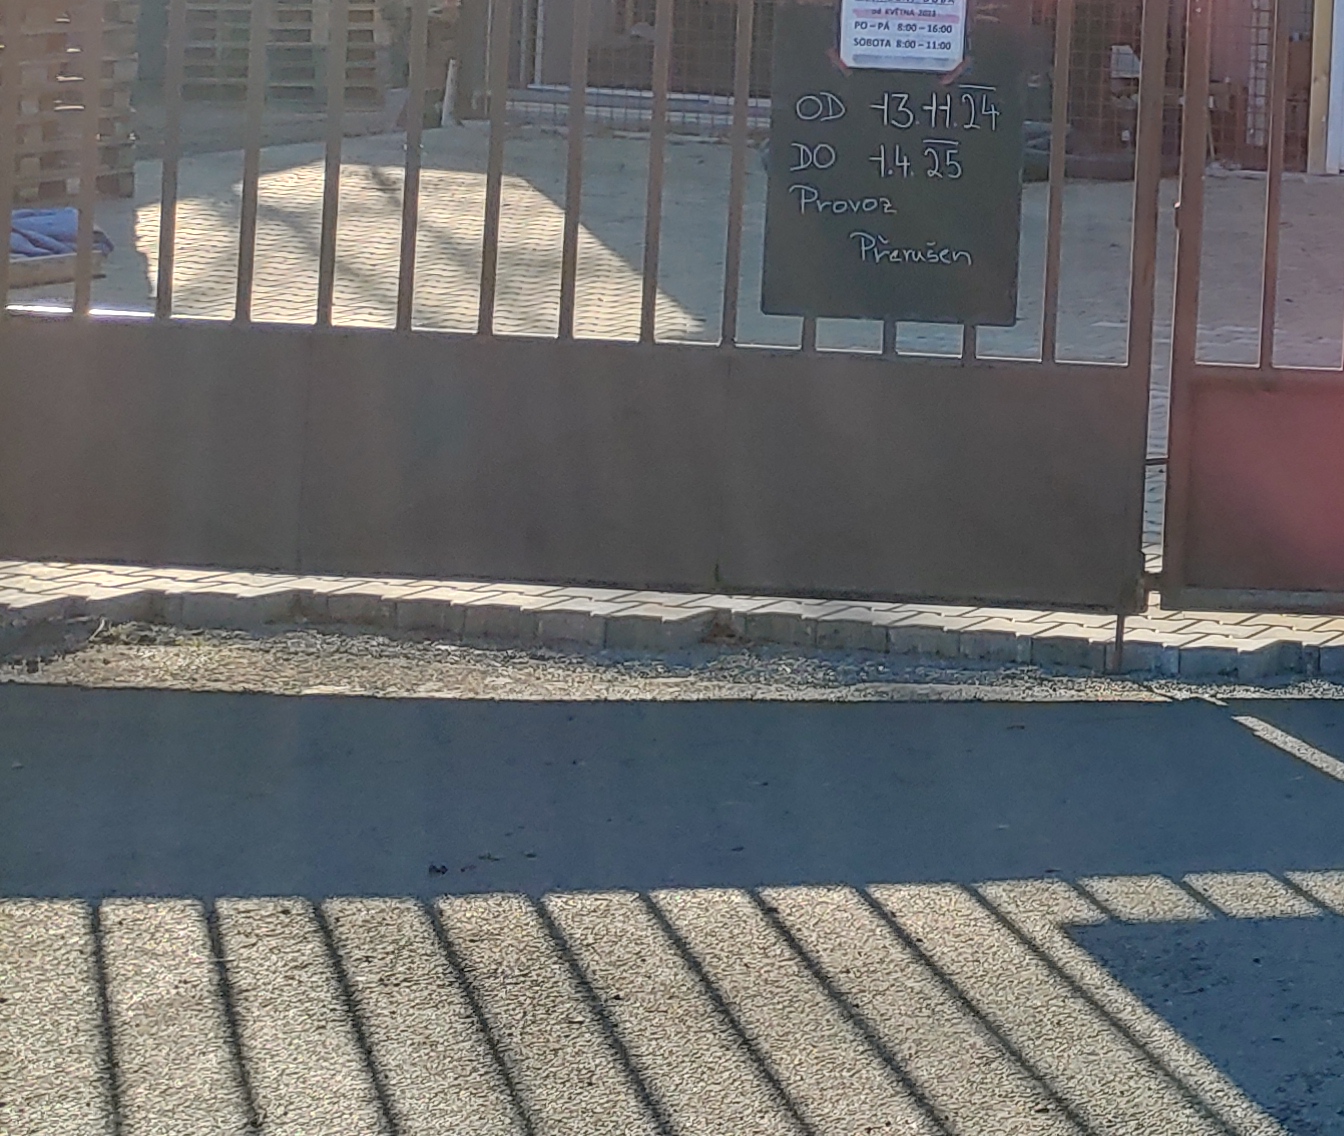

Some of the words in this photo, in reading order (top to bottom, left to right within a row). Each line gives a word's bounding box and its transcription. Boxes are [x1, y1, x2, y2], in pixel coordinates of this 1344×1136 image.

[853, 37, 891, 48] SOBOTA
[796, 92, 846, 121] OD
[789, 142, 836, 171] DO
[789, 185, 897, 214] Provoz
[850, 231, 973, 265] Přerušen
